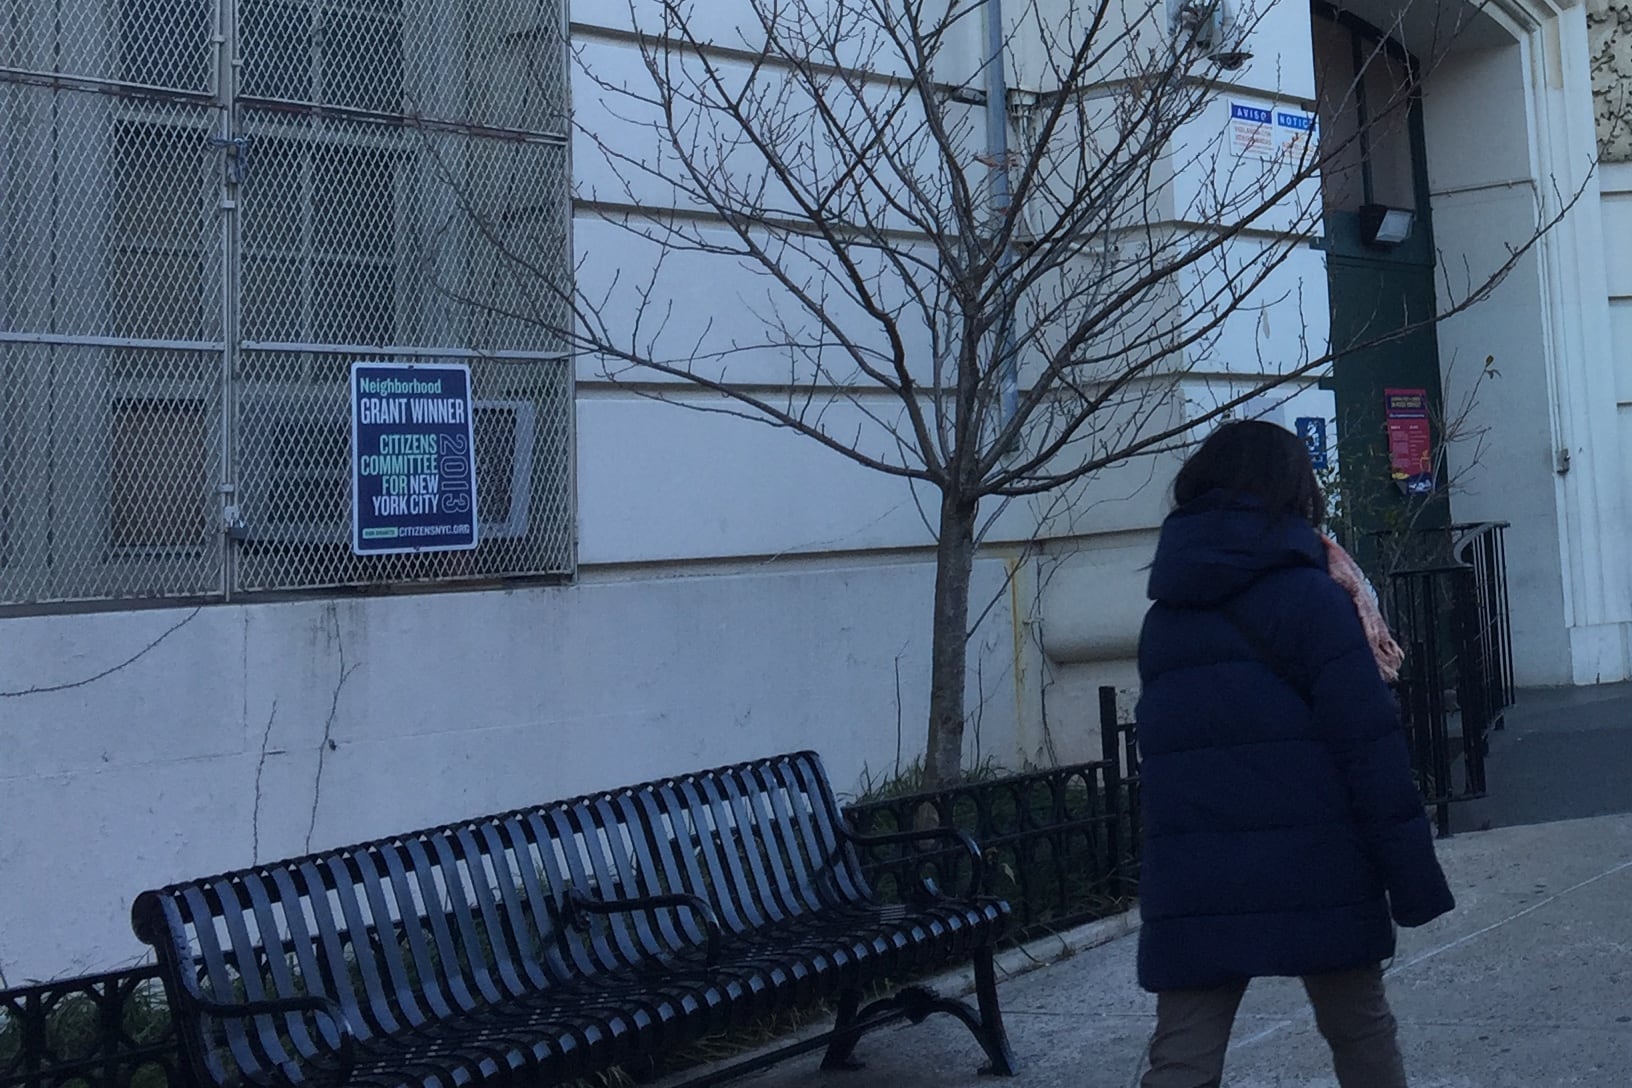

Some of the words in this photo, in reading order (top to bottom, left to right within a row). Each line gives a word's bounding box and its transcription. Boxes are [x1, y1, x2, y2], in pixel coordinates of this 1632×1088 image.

[1237, 108, 1267, 121] AVISO
[360, 378, 441, 396] Neighborhood
[361, 398, 407, 424] GRANT
[410, 398, 465, 424] WINNER
[379, 434, 437, 454] CITIZENS
[361, 455, 438, 475] COMMITTEE
[439, 433, 470, 514] 2013
[382, 476, 408, 495] FOR
[410, 475, 439, 494] NEW
[372, 495, 408, 516] YORK
[410, 494, 439, 514] CITY
[399, 525, 470, 537] CITIZENSNYC.ORG
